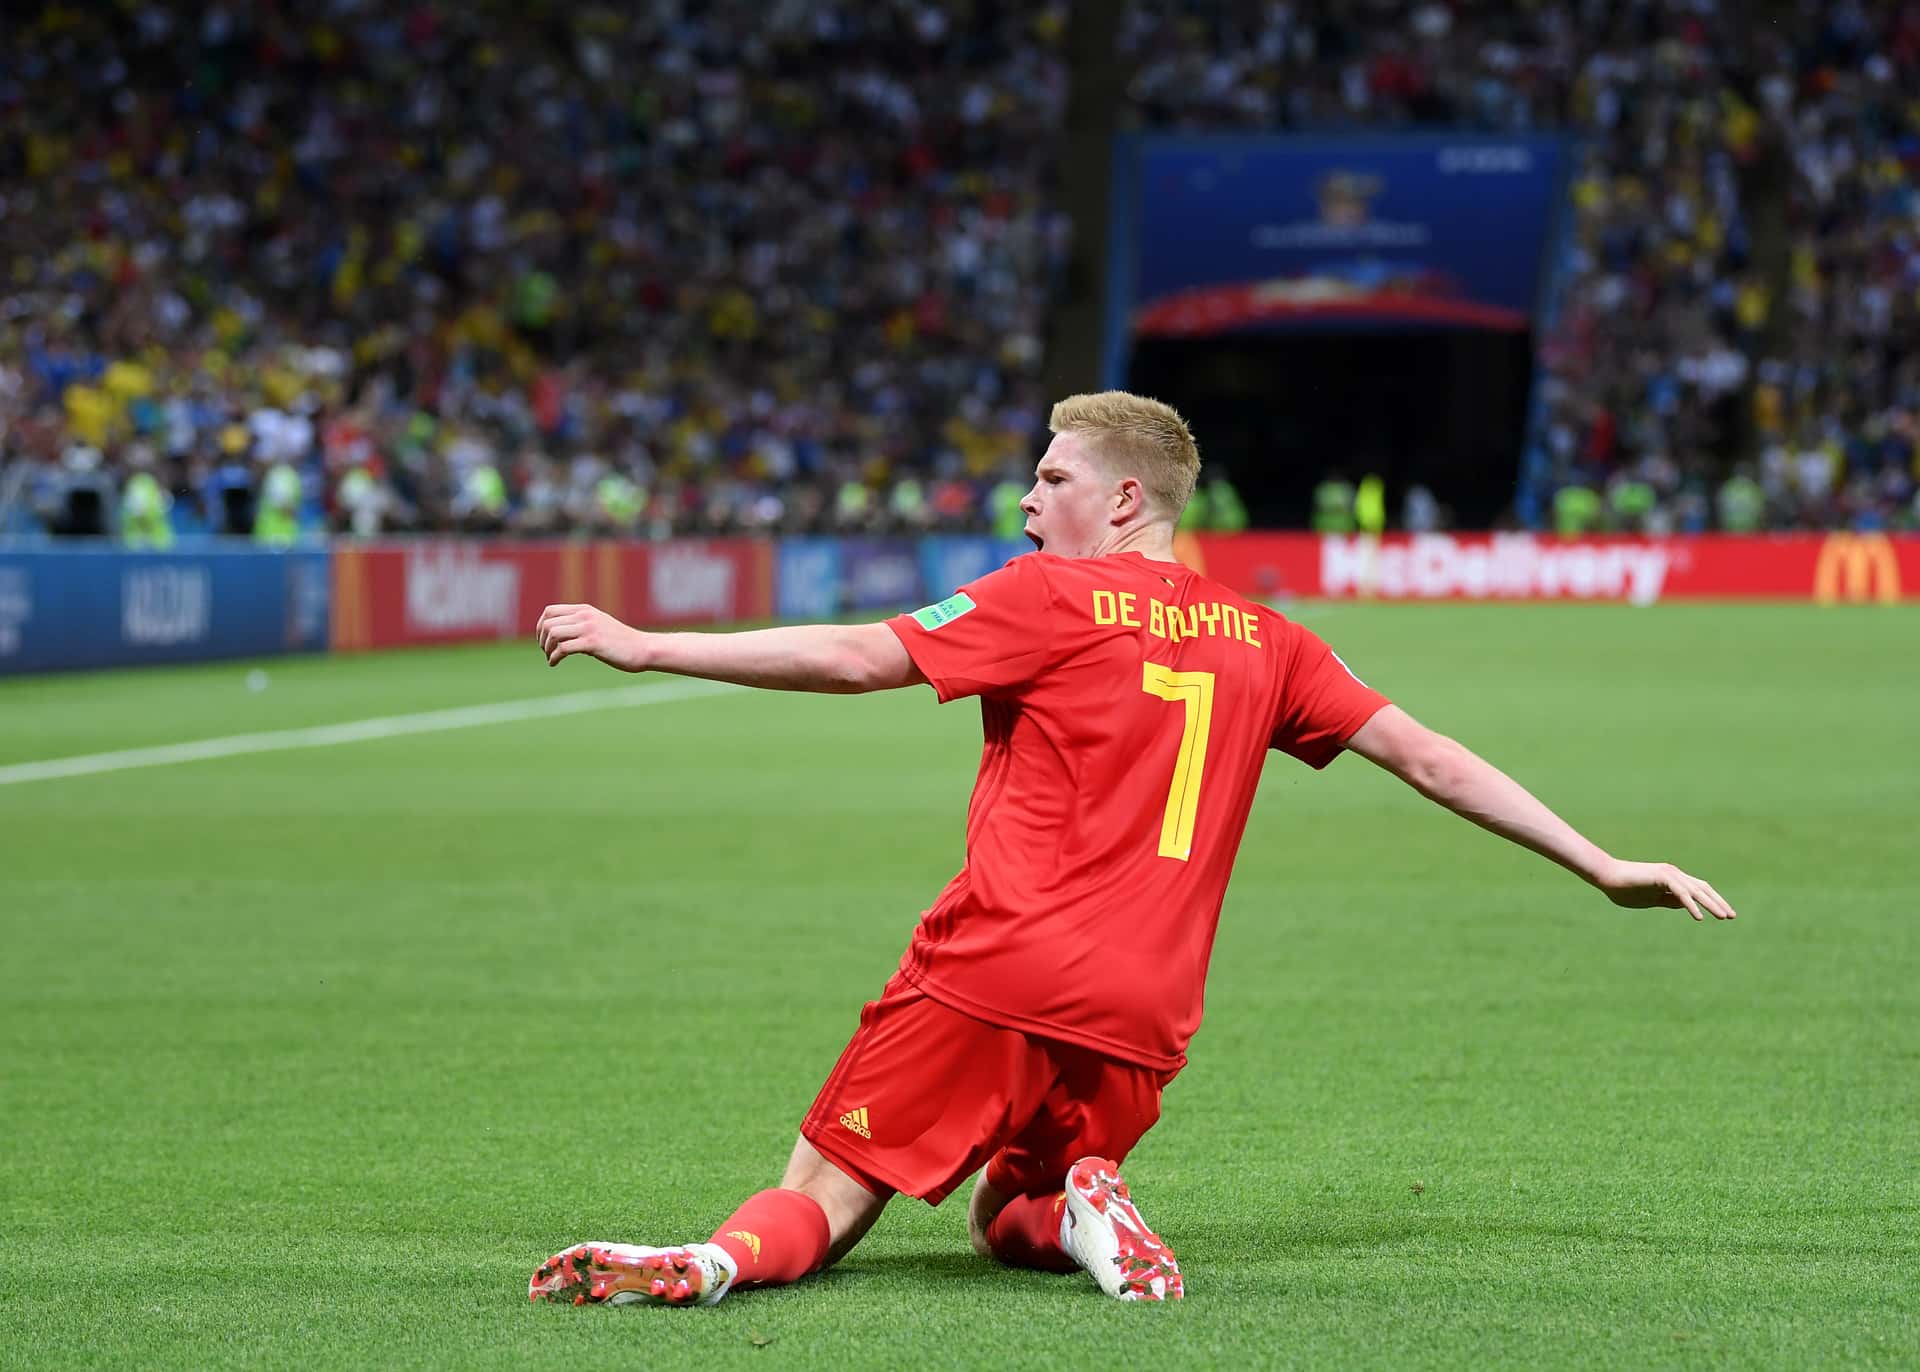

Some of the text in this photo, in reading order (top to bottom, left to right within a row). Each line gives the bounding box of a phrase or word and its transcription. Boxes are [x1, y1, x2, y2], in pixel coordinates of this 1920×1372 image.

[1092, 590, 1261, 648] DE BRUYNE
[1142, 661, 1215, 862] 7
[839, 1115, 872, 1139] adidas
